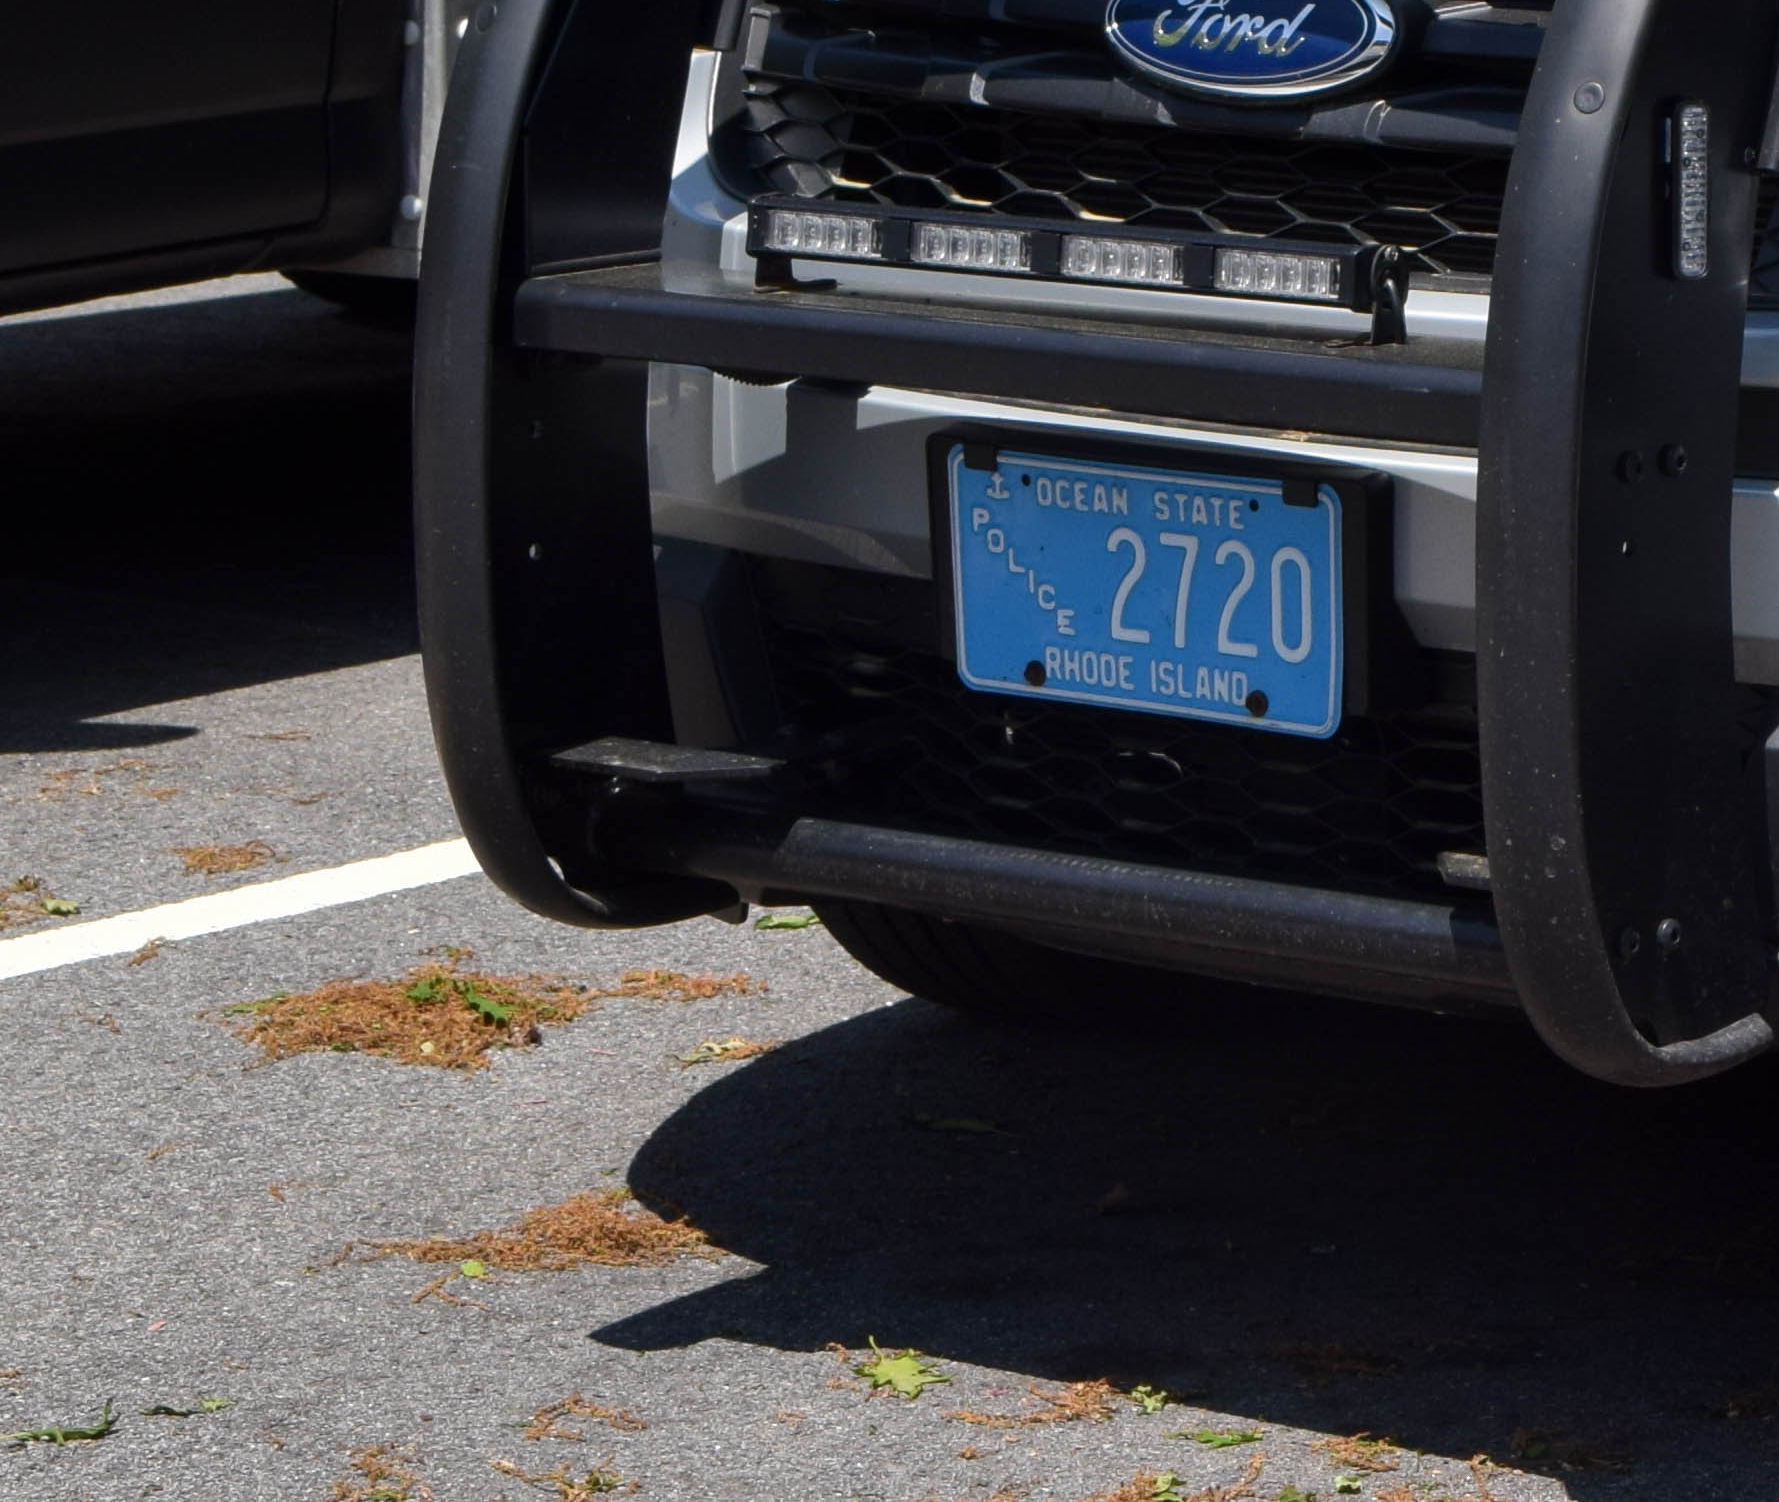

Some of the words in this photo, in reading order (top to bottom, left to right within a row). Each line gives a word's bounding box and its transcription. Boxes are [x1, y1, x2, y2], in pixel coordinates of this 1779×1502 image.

[1036, 476, 1128, 515] OCEAN
[1154, 495, 1245, 531] STATE
[972, 507, 1075, 636] POLICE
[1106, 527, 1312, 664] 2720
[1044, 646, 1135, 691] RHODE
[1150, 660, 1249, 707] ISLAND
